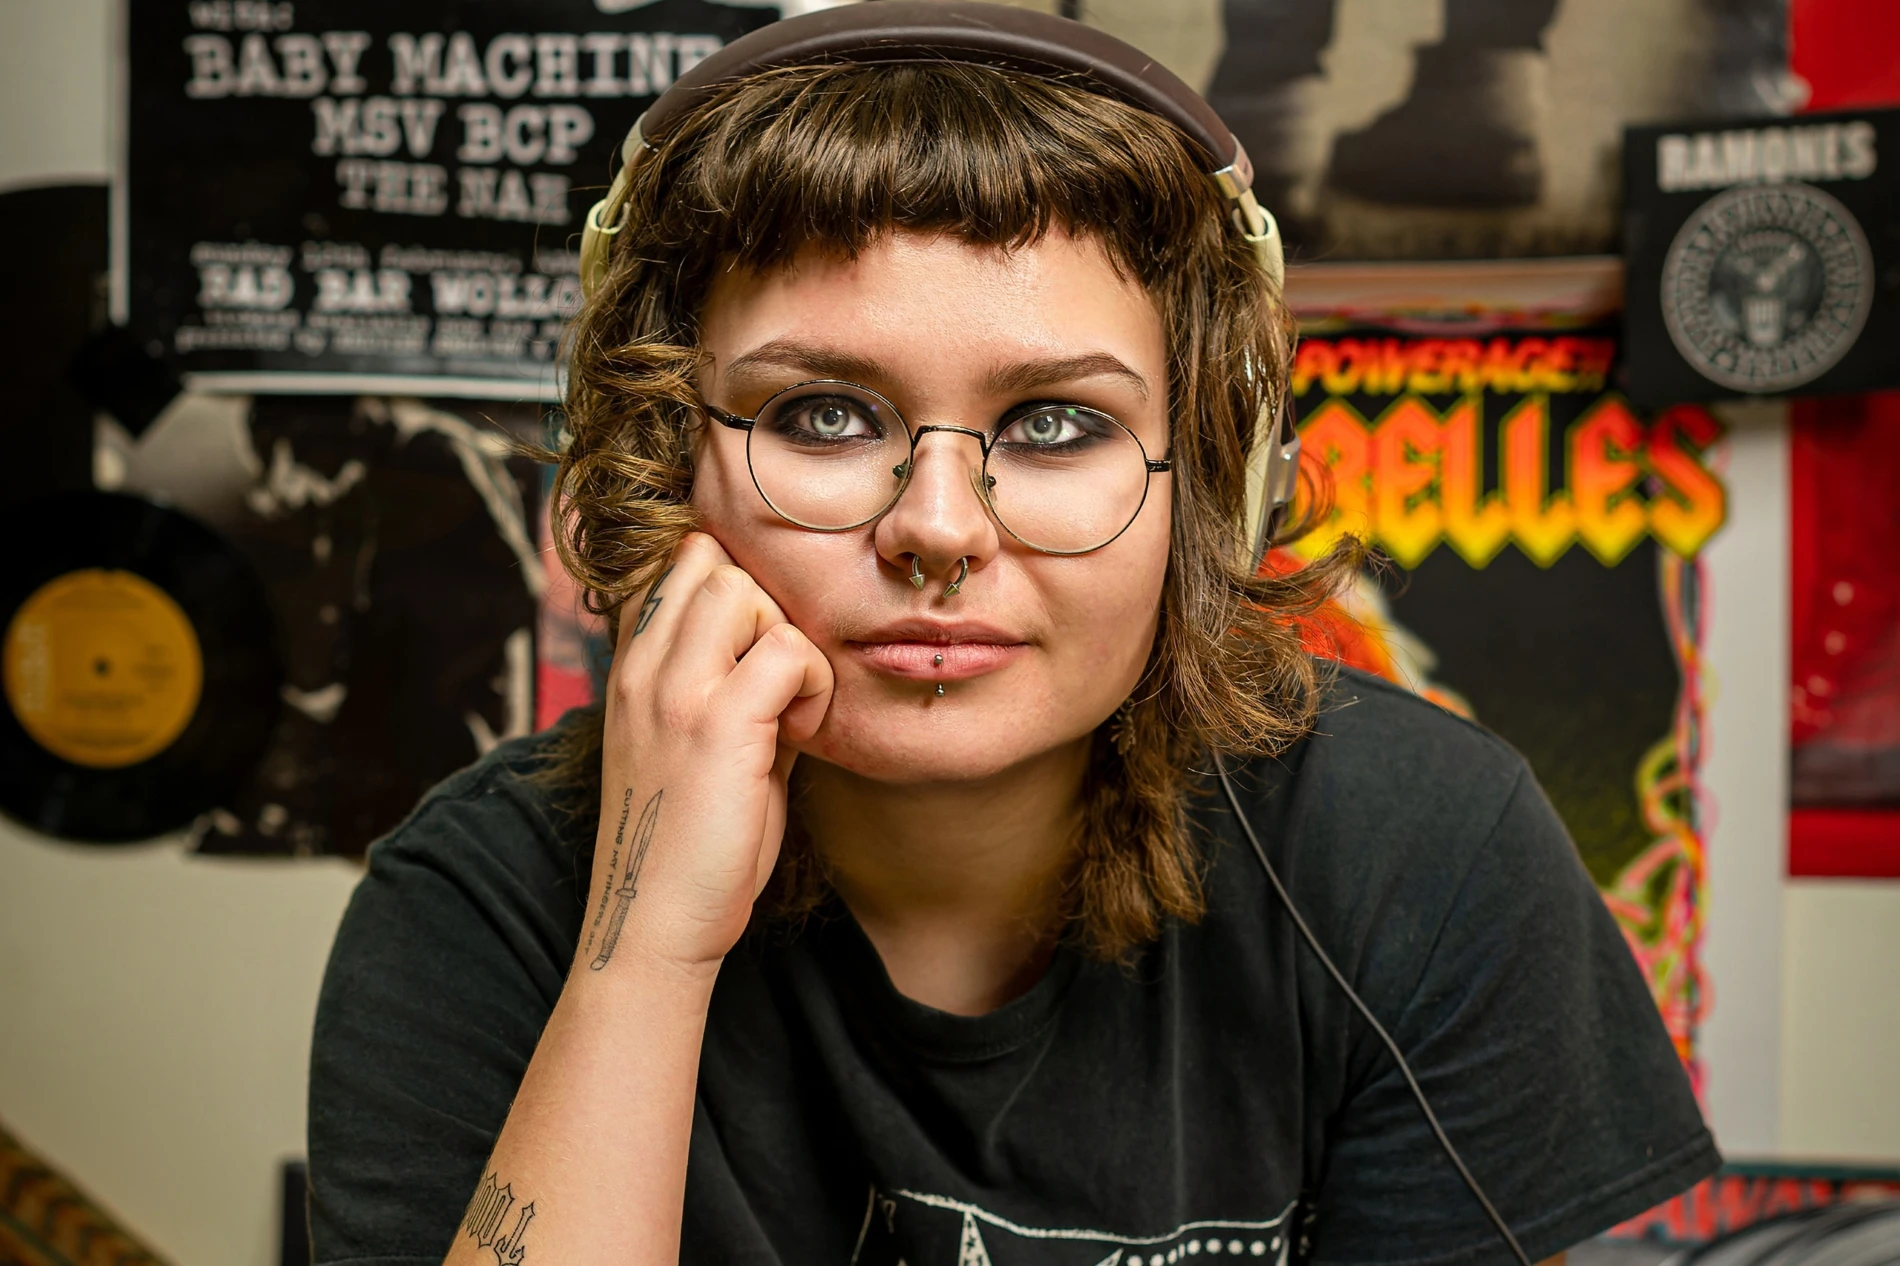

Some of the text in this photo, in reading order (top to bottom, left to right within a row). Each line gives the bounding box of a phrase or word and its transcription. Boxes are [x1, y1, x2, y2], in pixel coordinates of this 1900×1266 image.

[183, 31, 372, 97] BABY
[311, 96, 595, 165] MSV BCP
[1656, 121, 1877, 192] RAMONES
[336, 160, 448, 215] THE
[615, 788, 633, 845] CUTTING
[609, 850, 619, 871] MY
[593, 874, 613, 928] FINGERS
